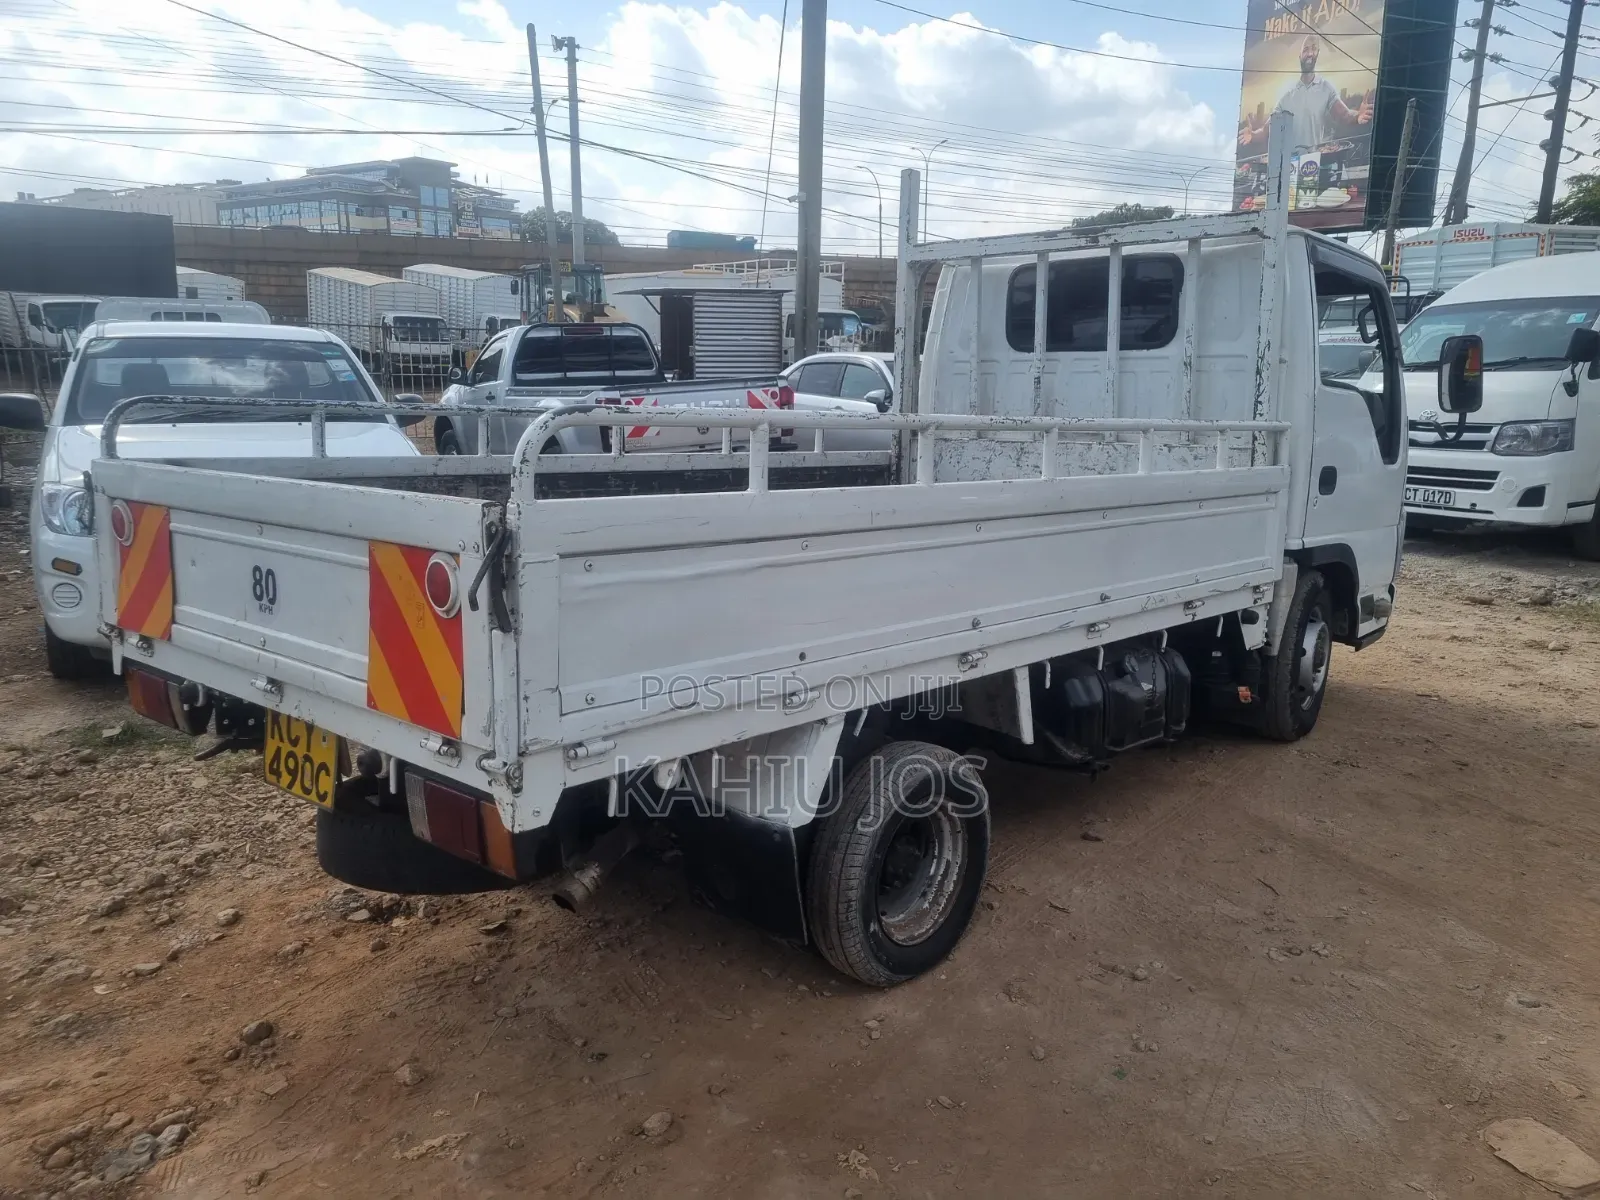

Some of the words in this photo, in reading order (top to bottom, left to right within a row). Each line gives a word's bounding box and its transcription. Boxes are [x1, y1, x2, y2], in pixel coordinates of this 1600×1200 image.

[1264, 12, 1298, 41] Make
[1453, 228, 1485, 238] ISUZU
[1422, 490, 1452, 504] 017D
[252, 564, 277, 606] 80
[258, 602, 274, 616] KPH
[270, 711, 315, 753] KCY
[268, 746, 331, 803] 490C
